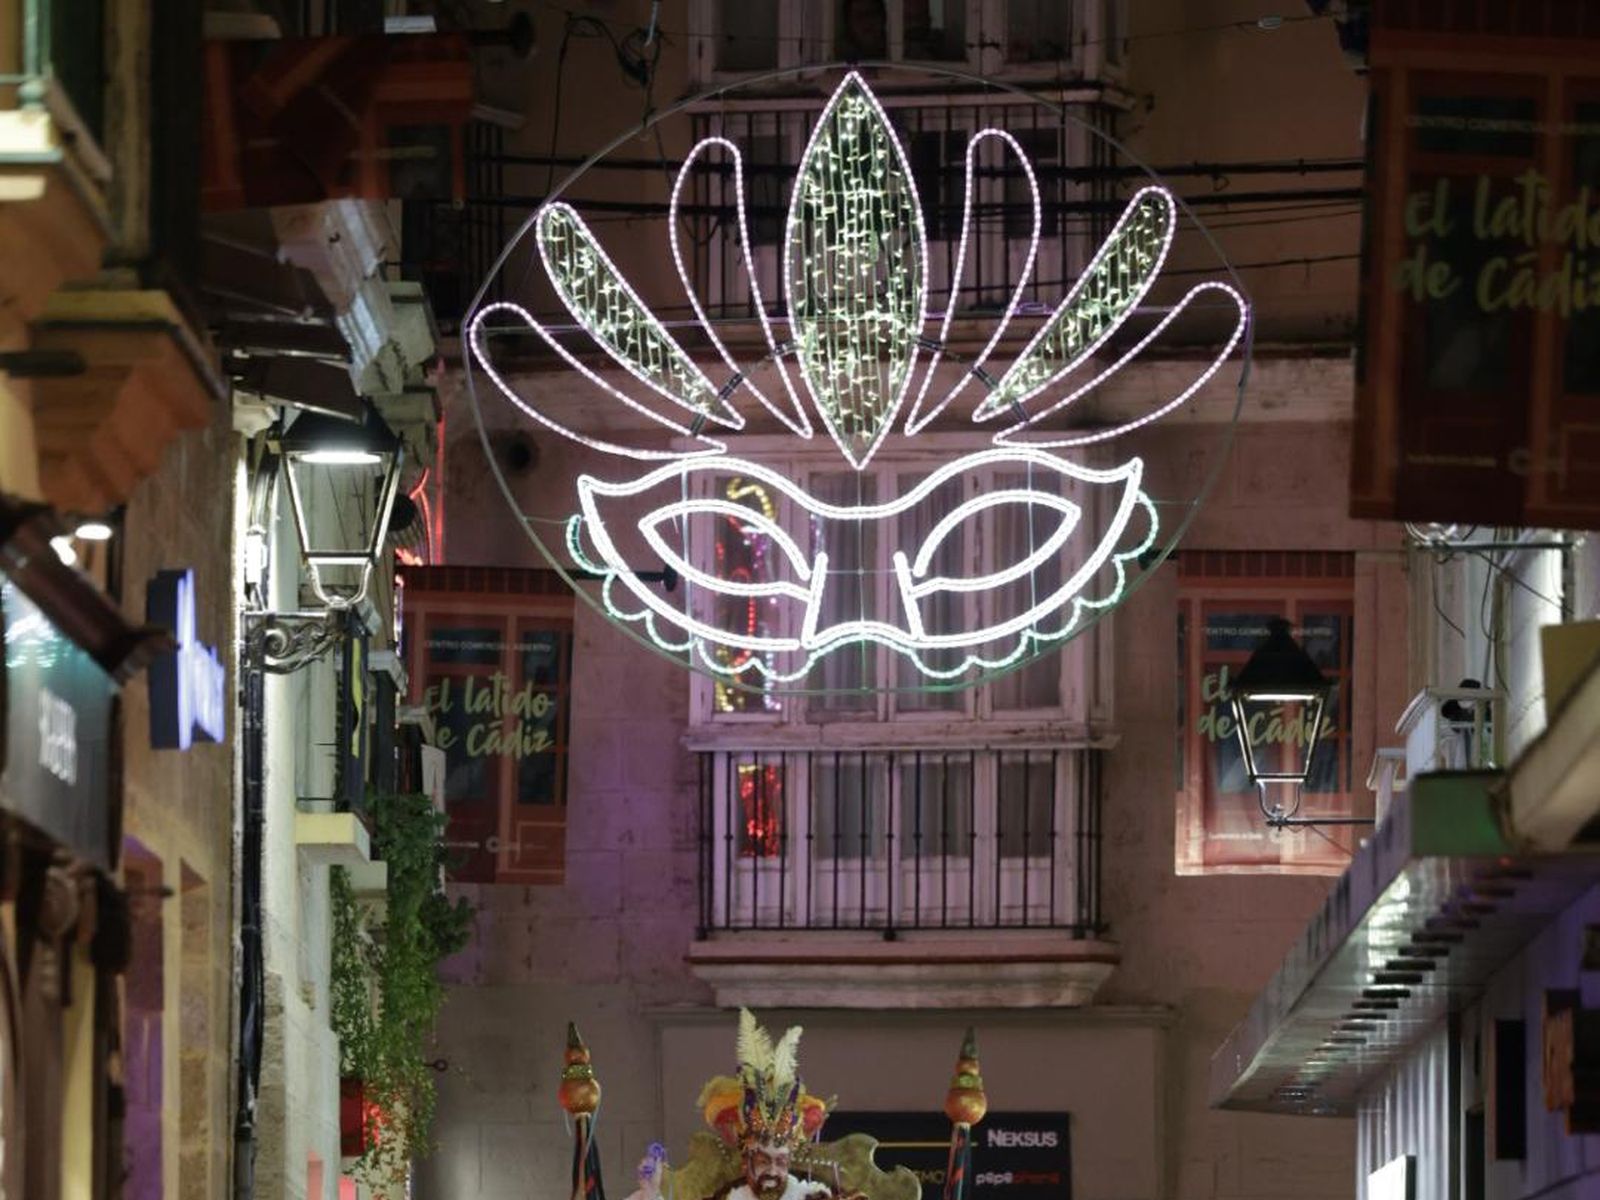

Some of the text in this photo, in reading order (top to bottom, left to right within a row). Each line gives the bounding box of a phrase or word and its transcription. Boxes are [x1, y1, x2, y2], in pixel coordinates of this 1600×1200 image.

[1392, 243, 1463, 303] de
[424, 670, 555, 719] El latido
[1201, 664, 1233, 703] El
[465, 719, 555, 760] Cádiz
[1196, 706, 1238, 742] de
